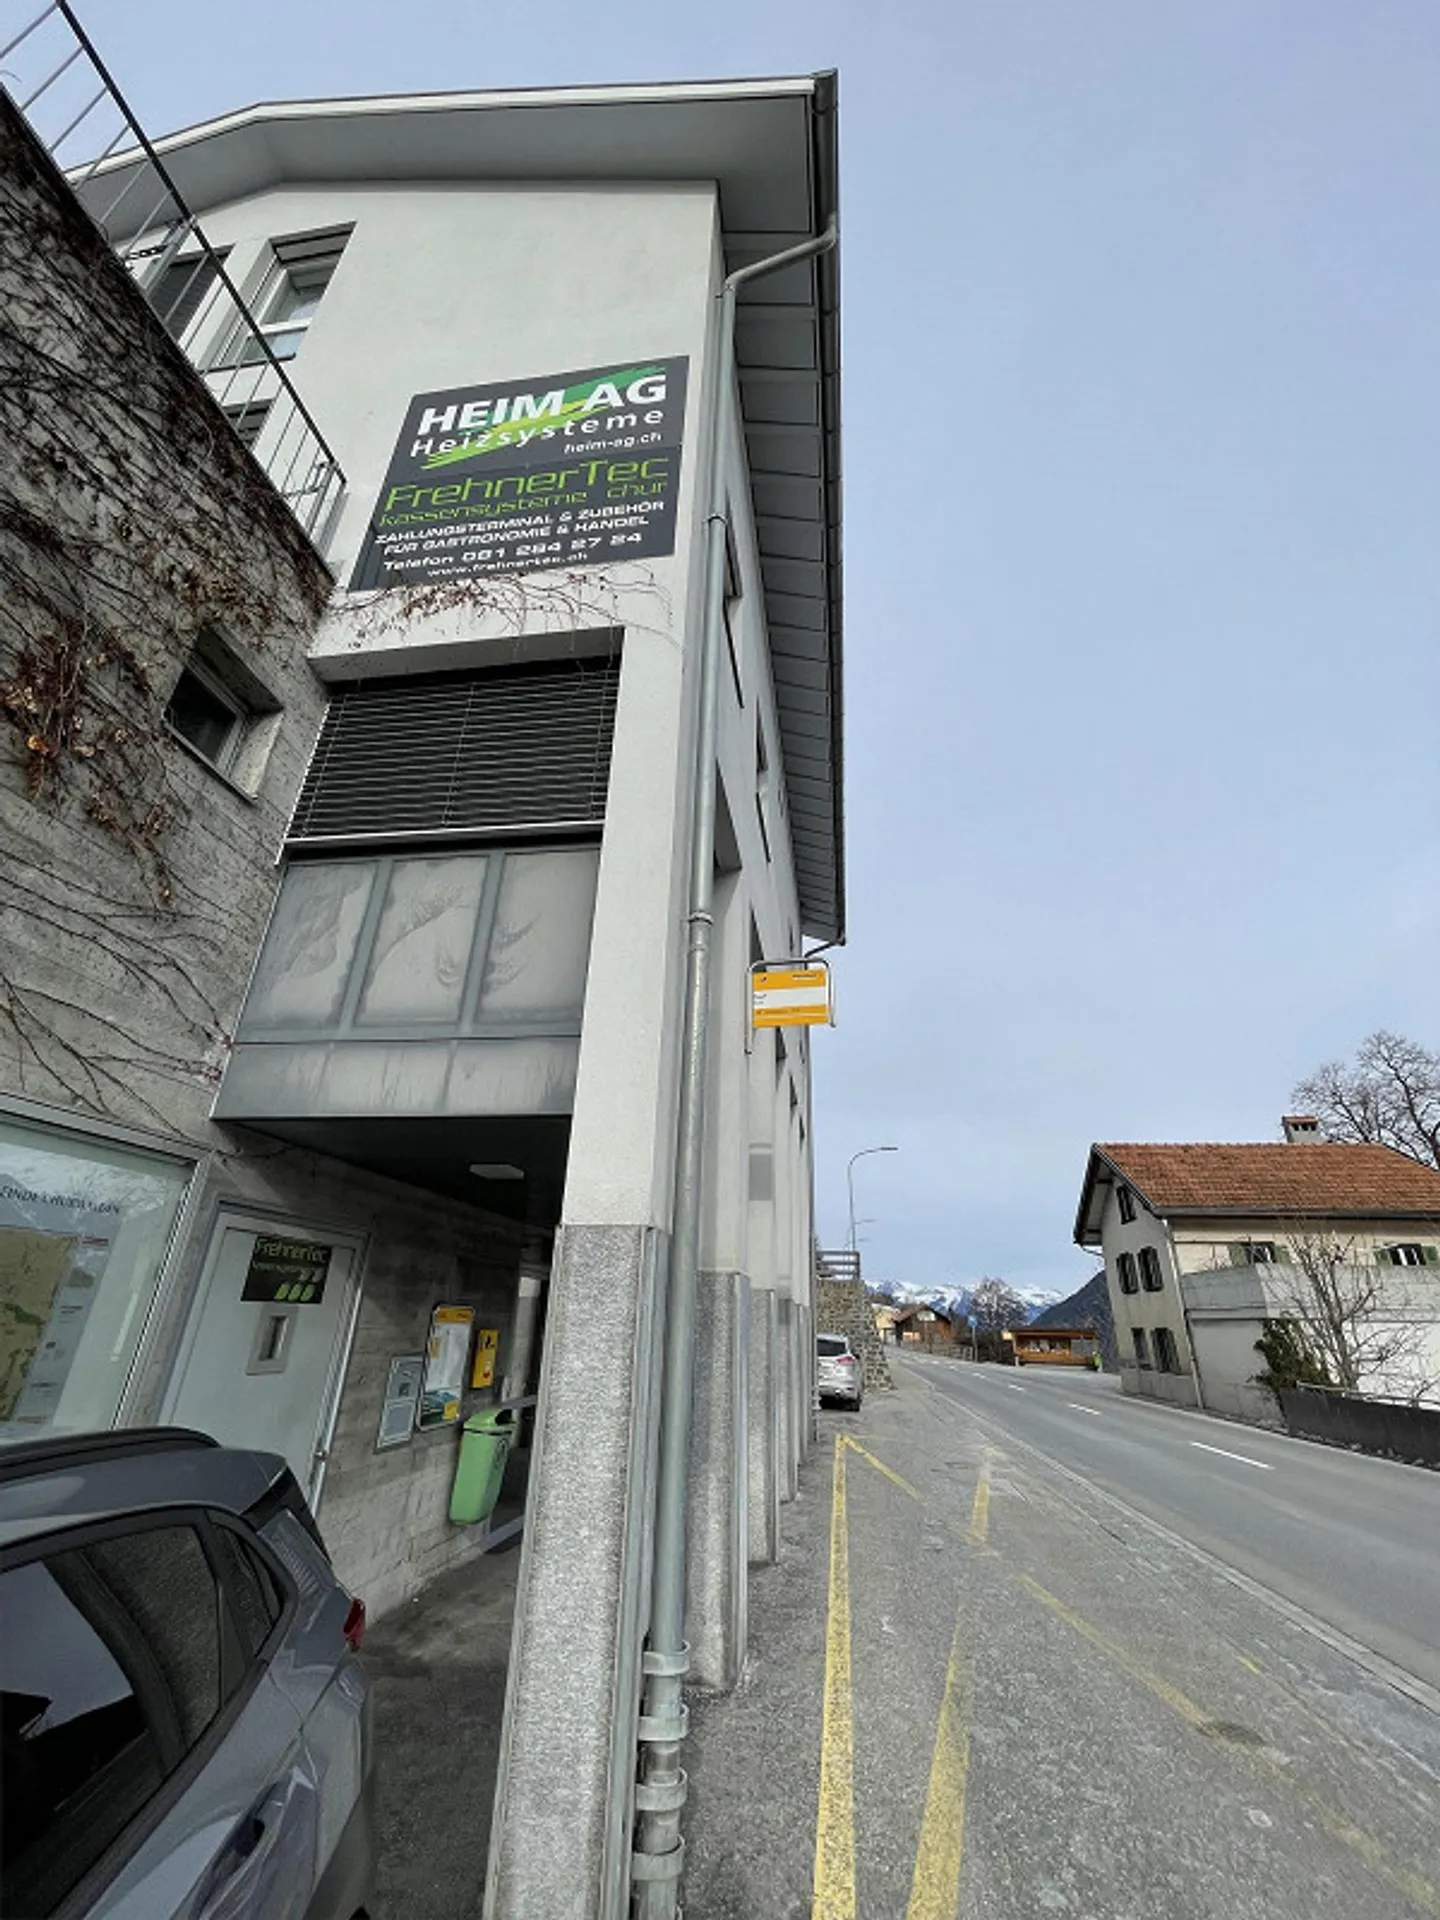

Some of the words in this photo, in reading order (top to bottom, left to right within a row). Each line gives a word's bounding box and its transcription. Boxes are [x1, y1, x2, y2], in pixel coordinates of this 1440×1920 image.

[418, 389, 565, 436] HEIM
[582, 374, 667, 411] AG
[410, 409, 664, 458] Heizsysteme
[564, 432, 662, 455] heim-ag.ch
[383, 458, 669, 512] FrehnerTec
[422, 525, 551, 551] GASTRONOMIE
[573, 515, 650, 532] HANDEL
[383, 555, 454, 571] Telefon
